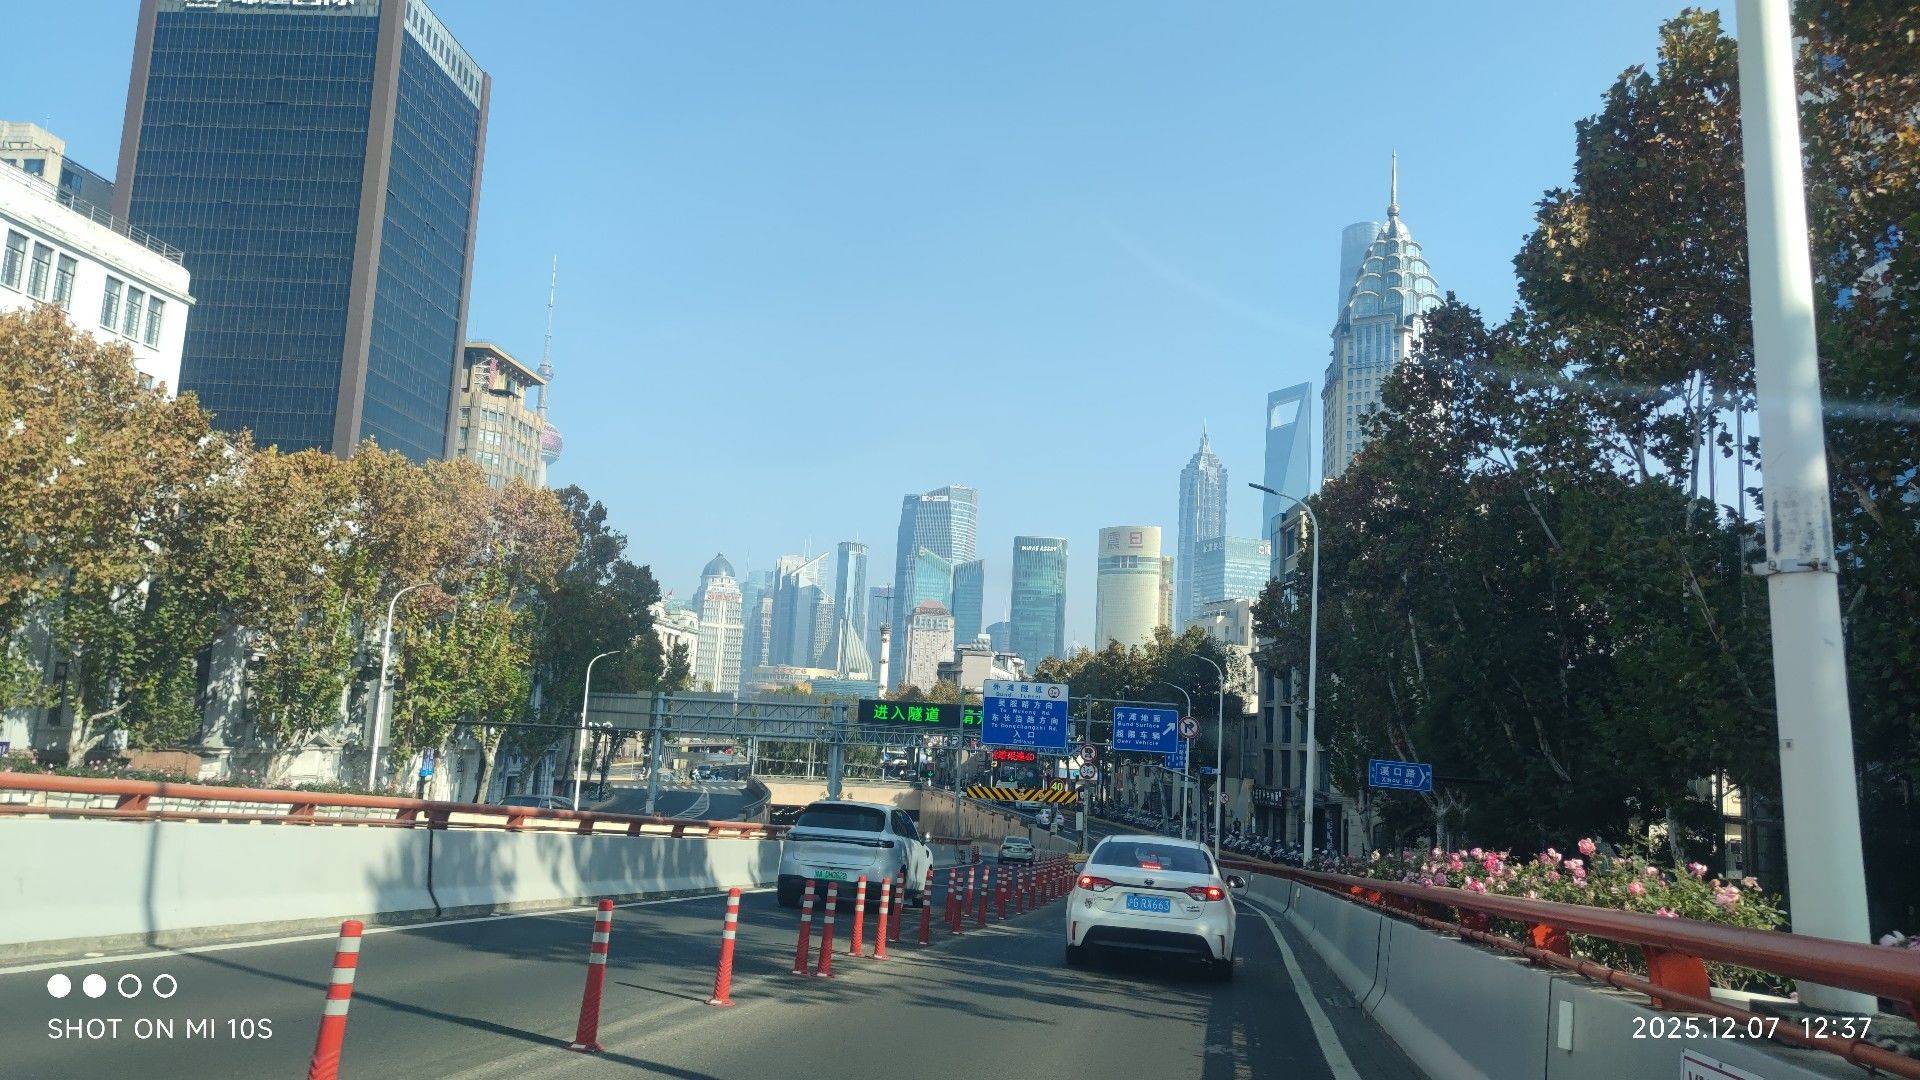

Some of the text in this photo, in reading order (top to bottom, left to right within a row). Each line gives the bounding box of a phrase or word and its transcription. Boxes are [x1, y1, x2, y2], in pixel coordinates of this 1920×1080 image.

[873, 703, 940, 723] 进入隧道
[1116, 711, 1161, 723] 外滩地面
[1013, 730, 1035, 738] 入口
[1051, 781, 1063, 791] 40
